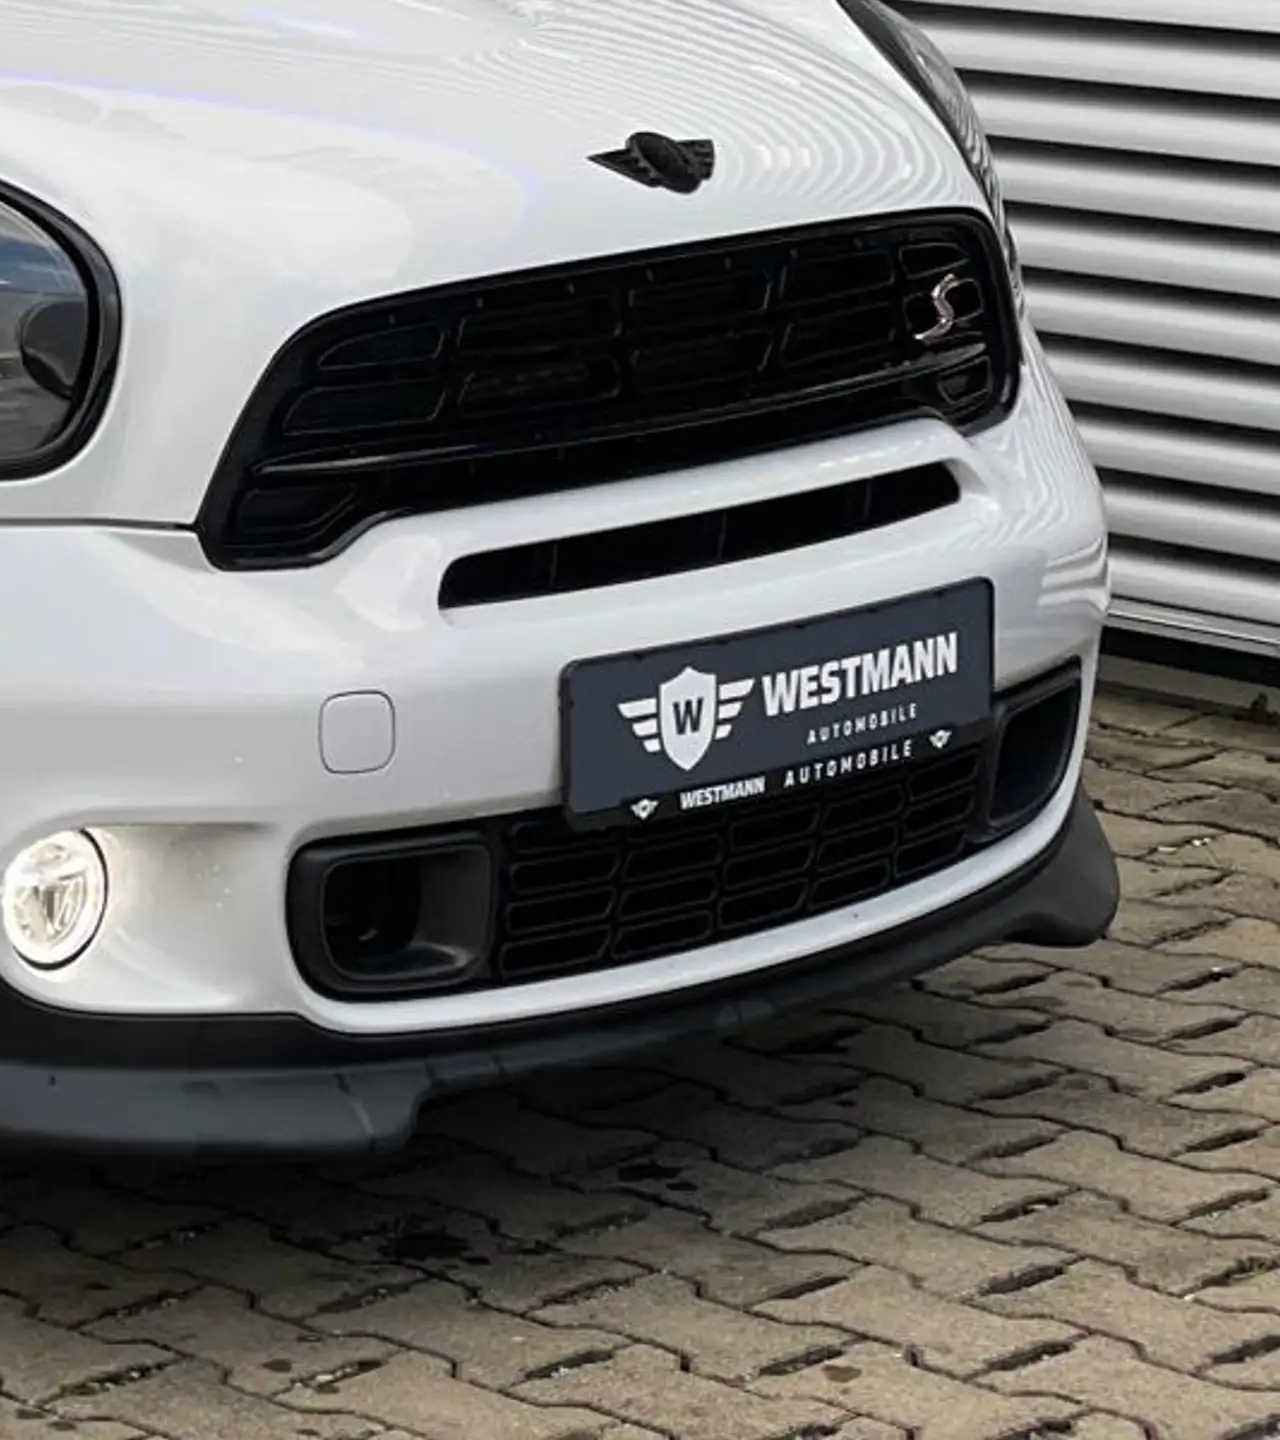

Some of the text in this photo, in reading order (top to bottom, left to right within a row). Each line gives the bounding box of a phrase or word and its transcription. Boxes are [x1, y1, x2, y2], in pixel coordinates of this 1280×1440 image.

[761, 631, 958, 717] WESTMANN
[672, 696, 705, 735] W
[806, 702, 918, 746] AUTOMOBILE
[679, 738, 913, 810] WESTMANN AUTOMOBILE
